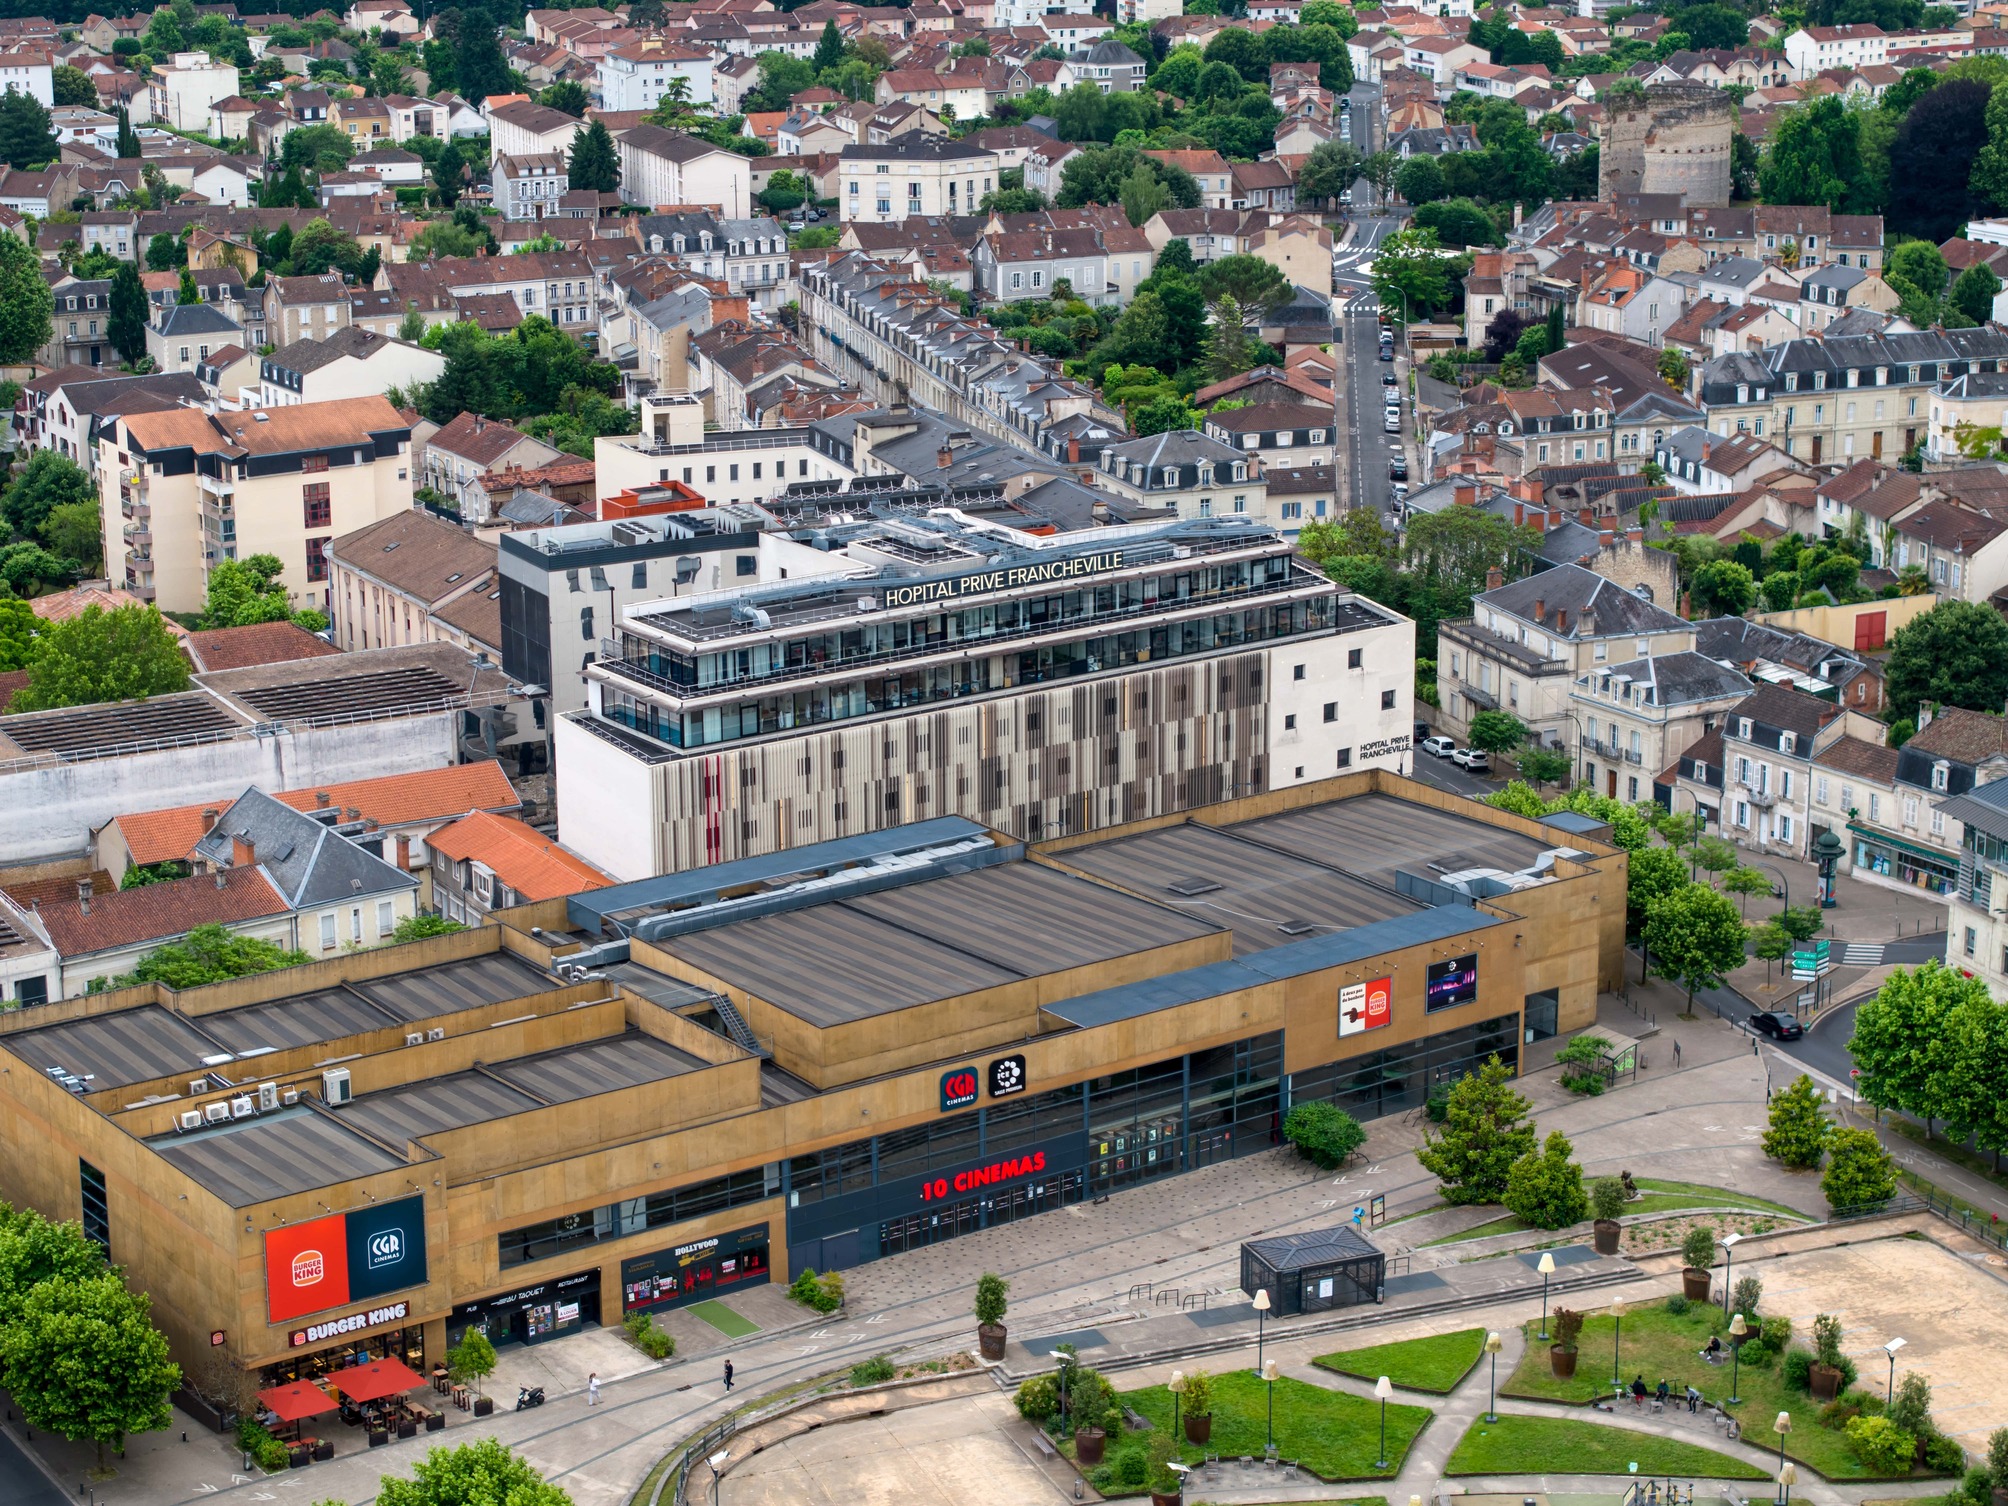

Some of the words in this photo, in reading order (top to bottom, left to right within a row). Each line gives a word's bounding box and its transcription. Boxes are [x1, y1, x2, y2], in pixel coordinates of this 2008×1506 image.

[886, 580, 957, 607] HOPITAL
[961, 572, 1004, 594] PRIVE
[1008, 552, 1123, 586] FRANCHEVILLE
[1360, 740, 1388, 752] HOPITAL
[1391, 735, 1410, 745] PRIVE
[1360, 743, 1410, 760] FRANCHEVILLE
[1370, 1002, 1385, 1010] KING
[945, 1073, 975, 1099] CGR
[946, 1094, 974, 1106] CINEMAS
[923, 1178, 948, 1201] 10
[953, 1151, 1046, 1192] CINEMAS
[372, 1234, 400, 1256] CGR
[675, 1238, 718, 1256] HOLLYWOOD
[293, 1259, 322, 1272] BURGER
[374, 1252, 400, 1263] CINEMAS
[294, 1266, 322, 1281] KING
[518, 1286, 545, 1300] TAQUET
[466, 1305, 478, 1313] PUB
[307, 1314, 367, 1342] BURGER
[368, 1303, 406, 1326] KING
